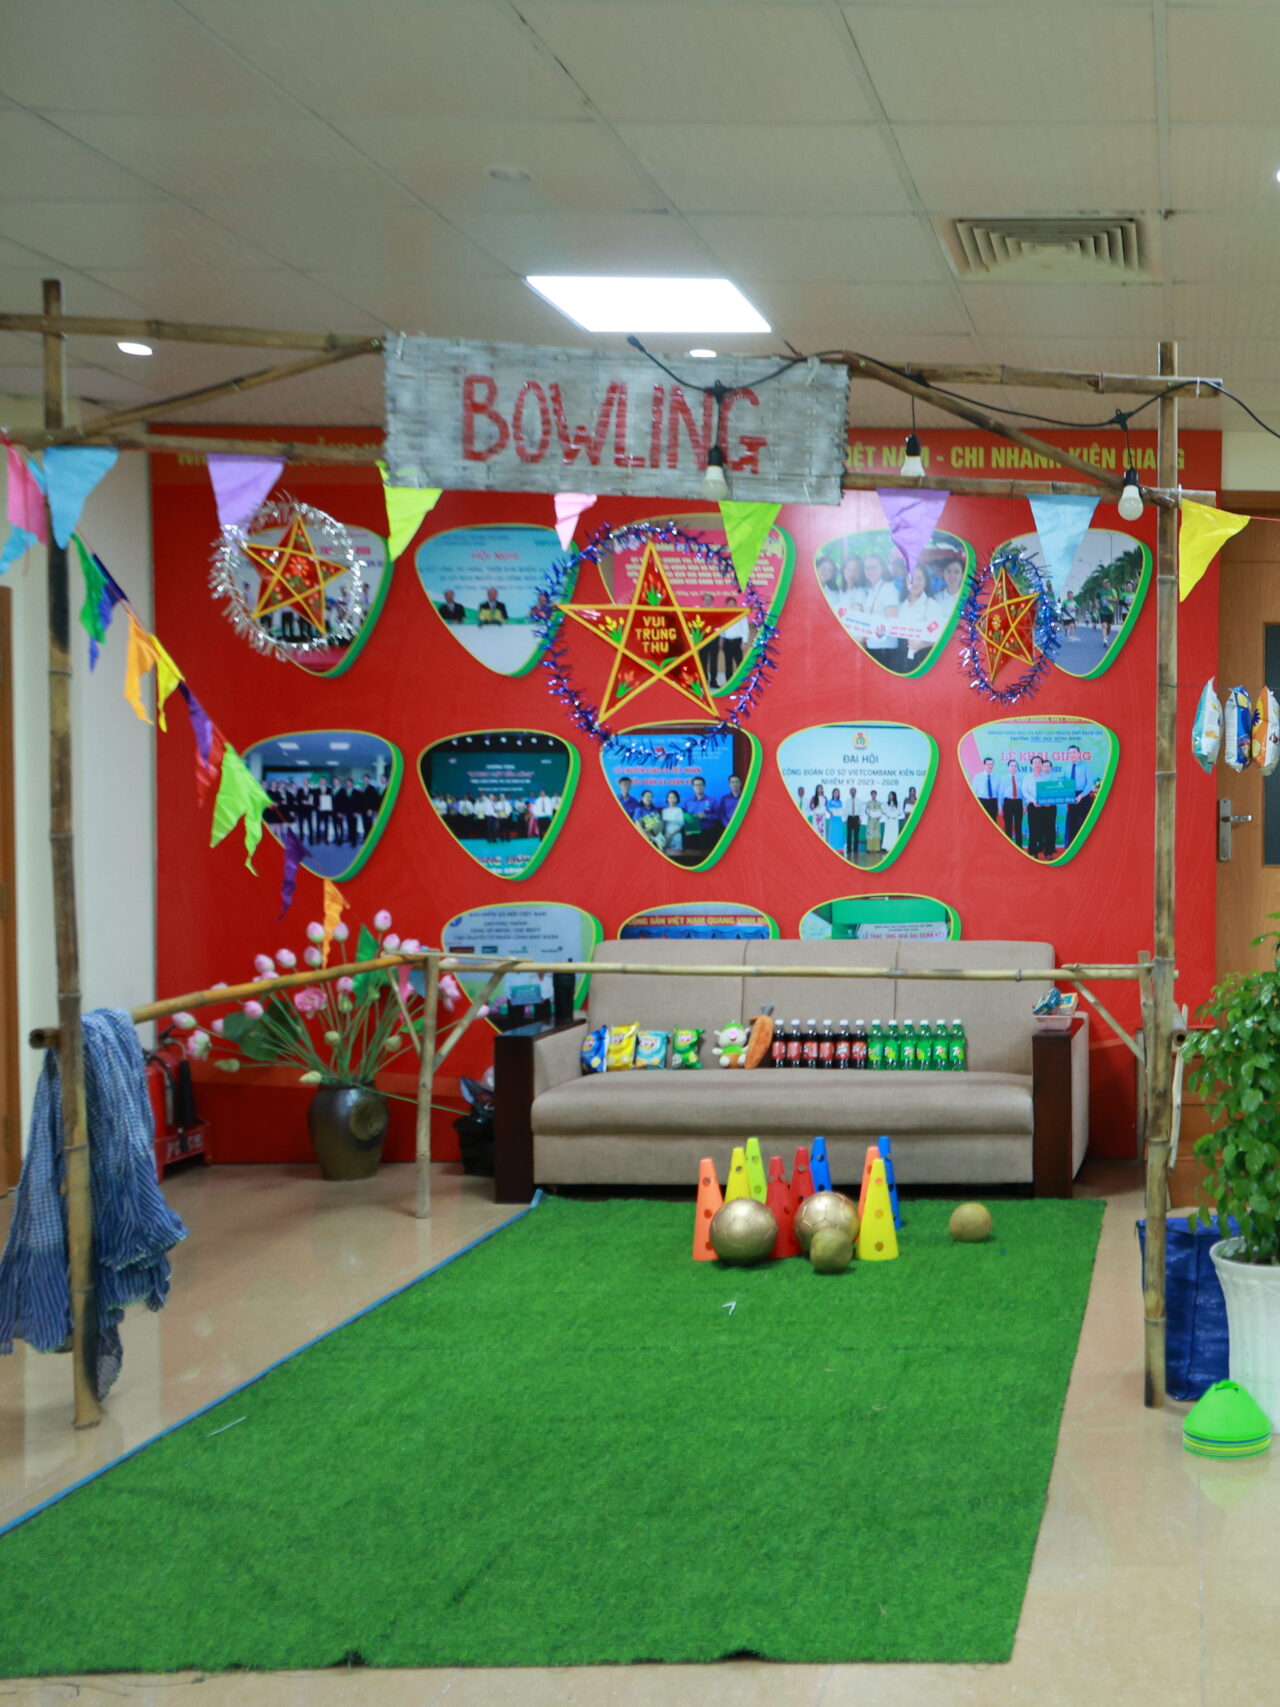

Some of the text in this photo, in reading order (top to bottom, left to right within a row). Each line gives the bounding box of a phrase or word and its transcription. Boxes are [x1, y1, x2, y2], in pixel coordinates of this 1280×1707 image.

[462, 373, 767, 474] BOWLING
[846, 441, 876, 472] IỆT
[951, 446, 984, 469] CHI
[1123, 445, 1185, 470] GIAG
[642, 616, 665, 627] VUI
[634, 628, 677, 640] TRUNG
[641, 641, 669, 654] THU
